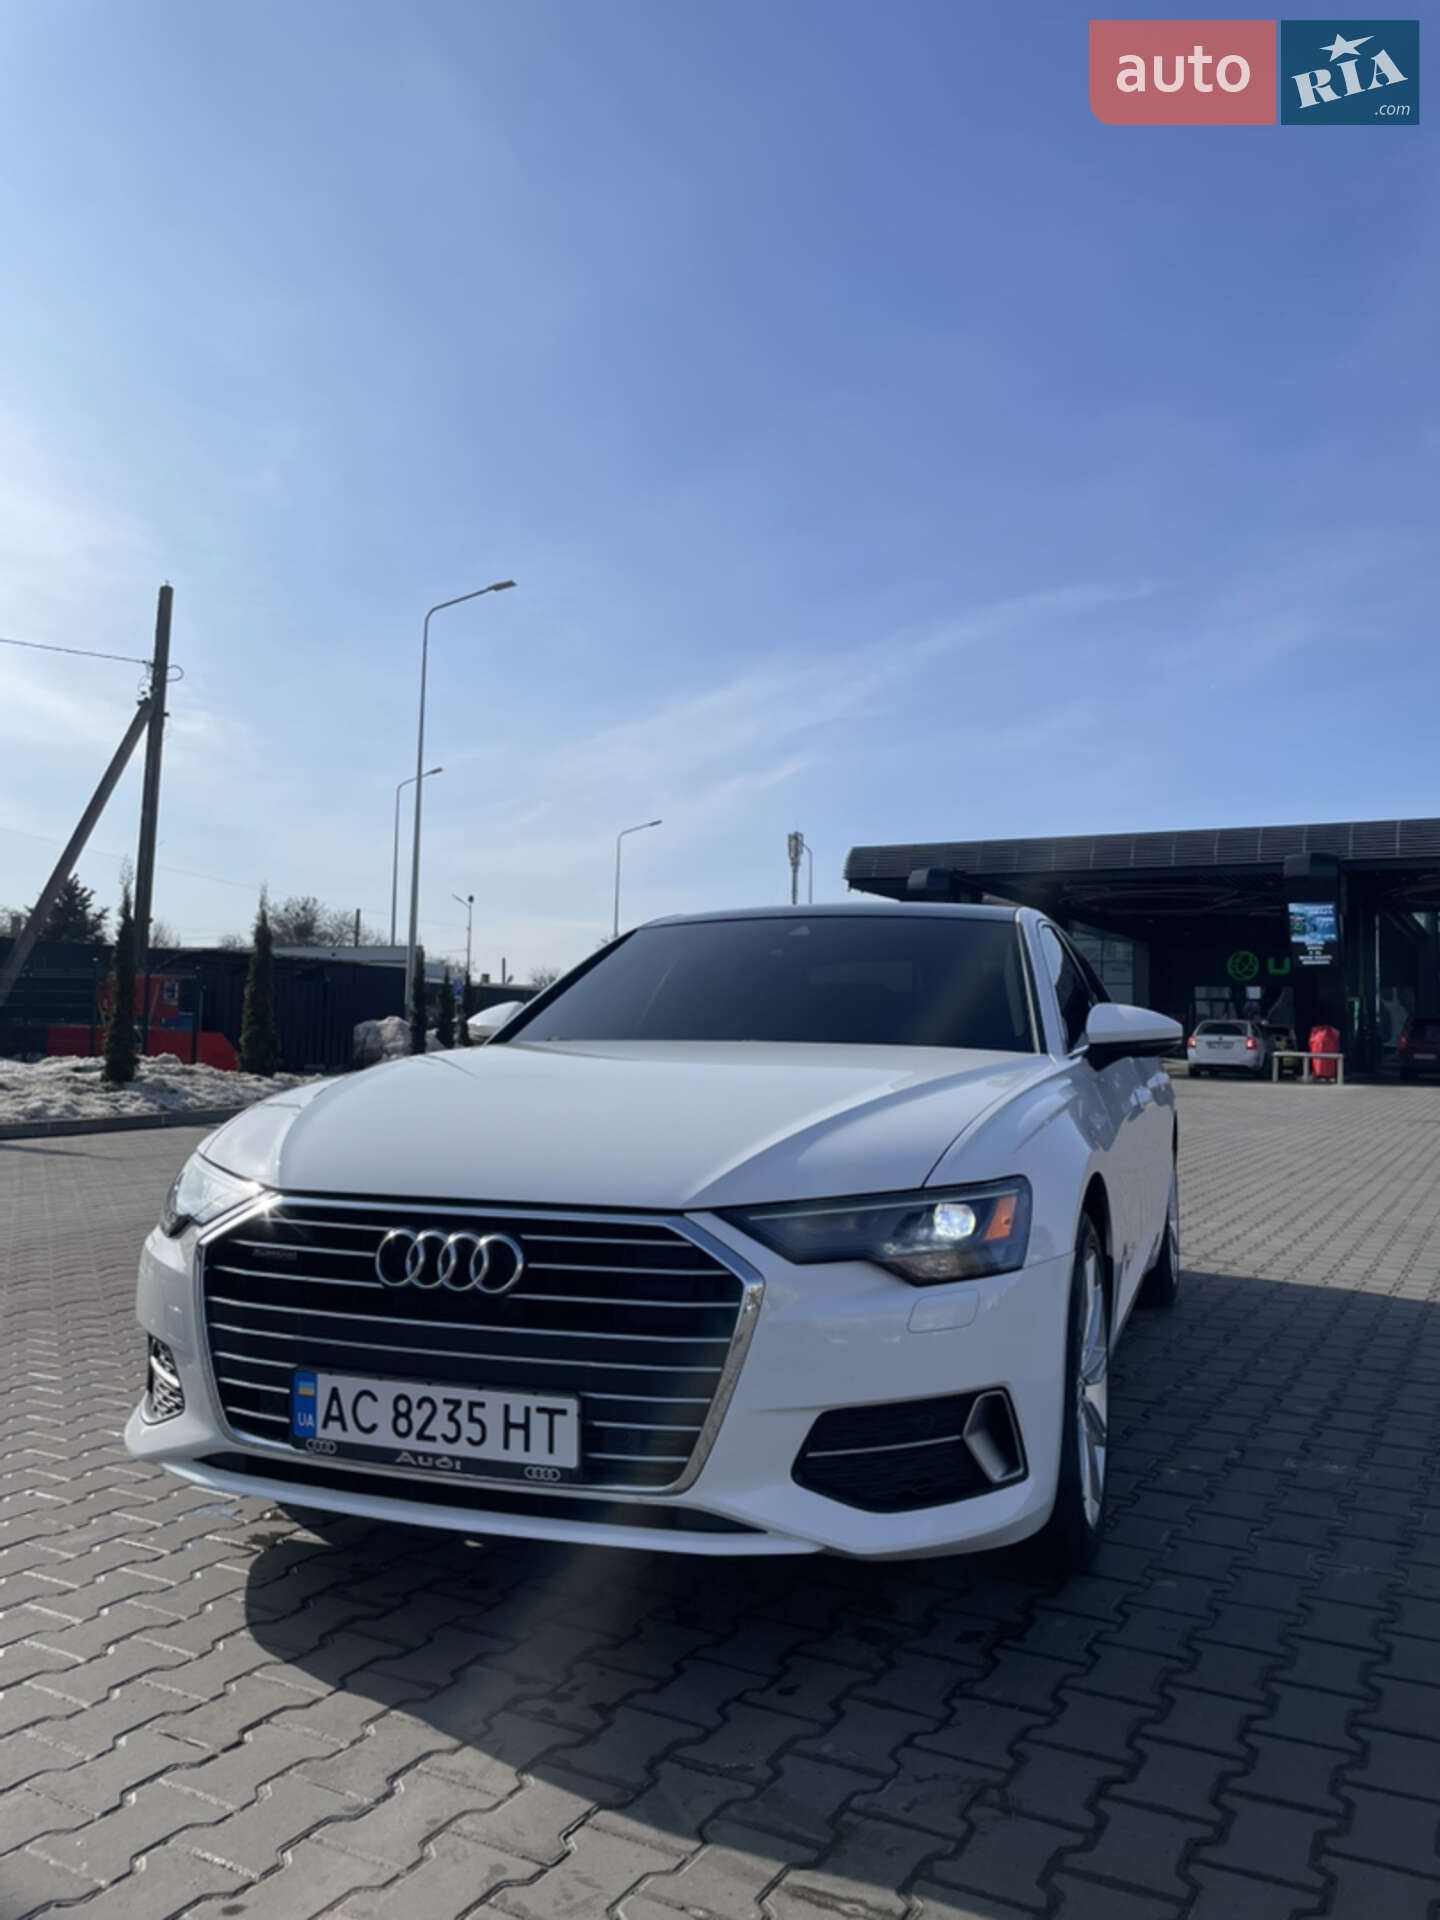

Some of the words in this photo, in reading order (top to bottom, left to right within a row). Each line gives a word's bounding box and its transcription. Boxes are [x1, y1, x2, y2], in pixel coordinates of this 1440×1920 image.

[297, 1410, 315, 1427] UA
[322, 1386, 378, 1435] AC
[391, 1393, 487, 1447] 8235
[503, 1403, 568, 1455] HT
[395, 1450, 462, 1471] Audi
